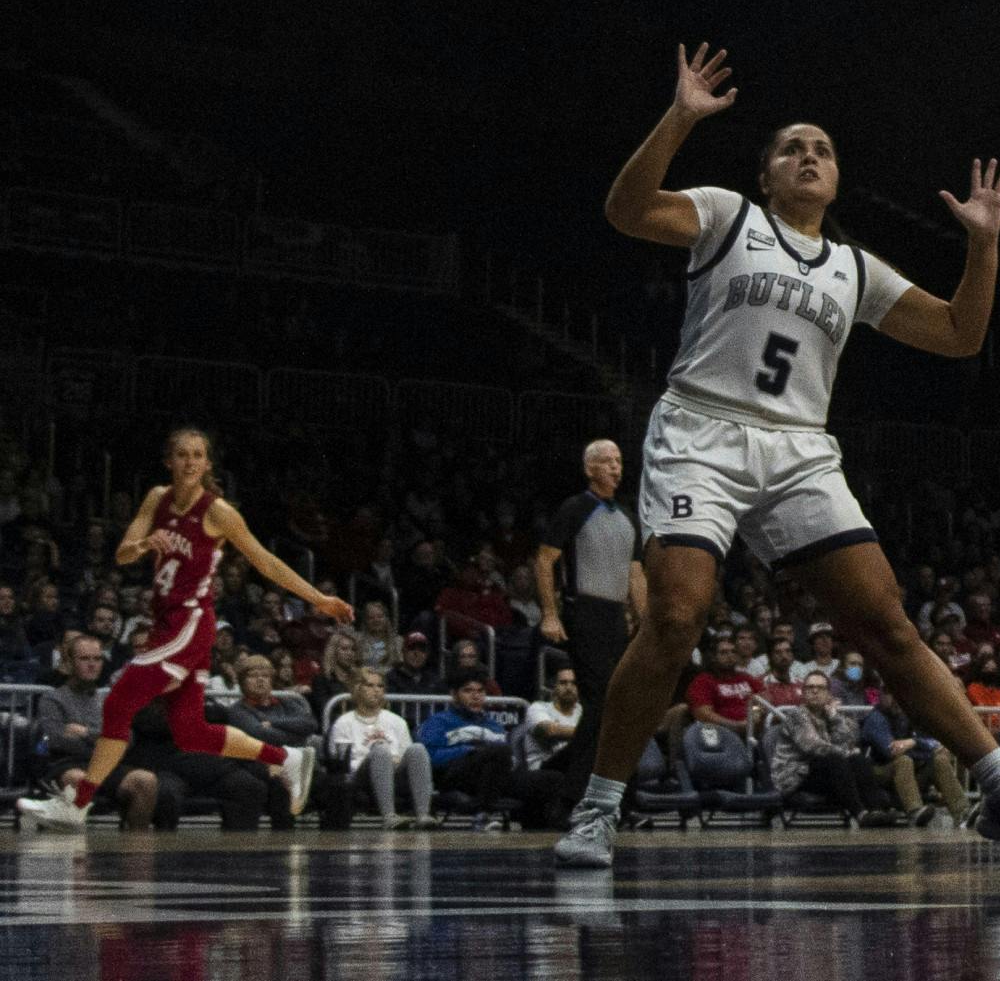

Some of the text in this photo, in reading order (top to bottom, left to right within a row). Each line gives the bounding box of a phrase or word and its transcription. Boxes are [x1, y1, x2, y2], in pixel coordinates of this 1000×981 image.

[755, 331, 800, 396] 5
[670, 494, 694, 519] B
[155, 559, 181, 597] 4
